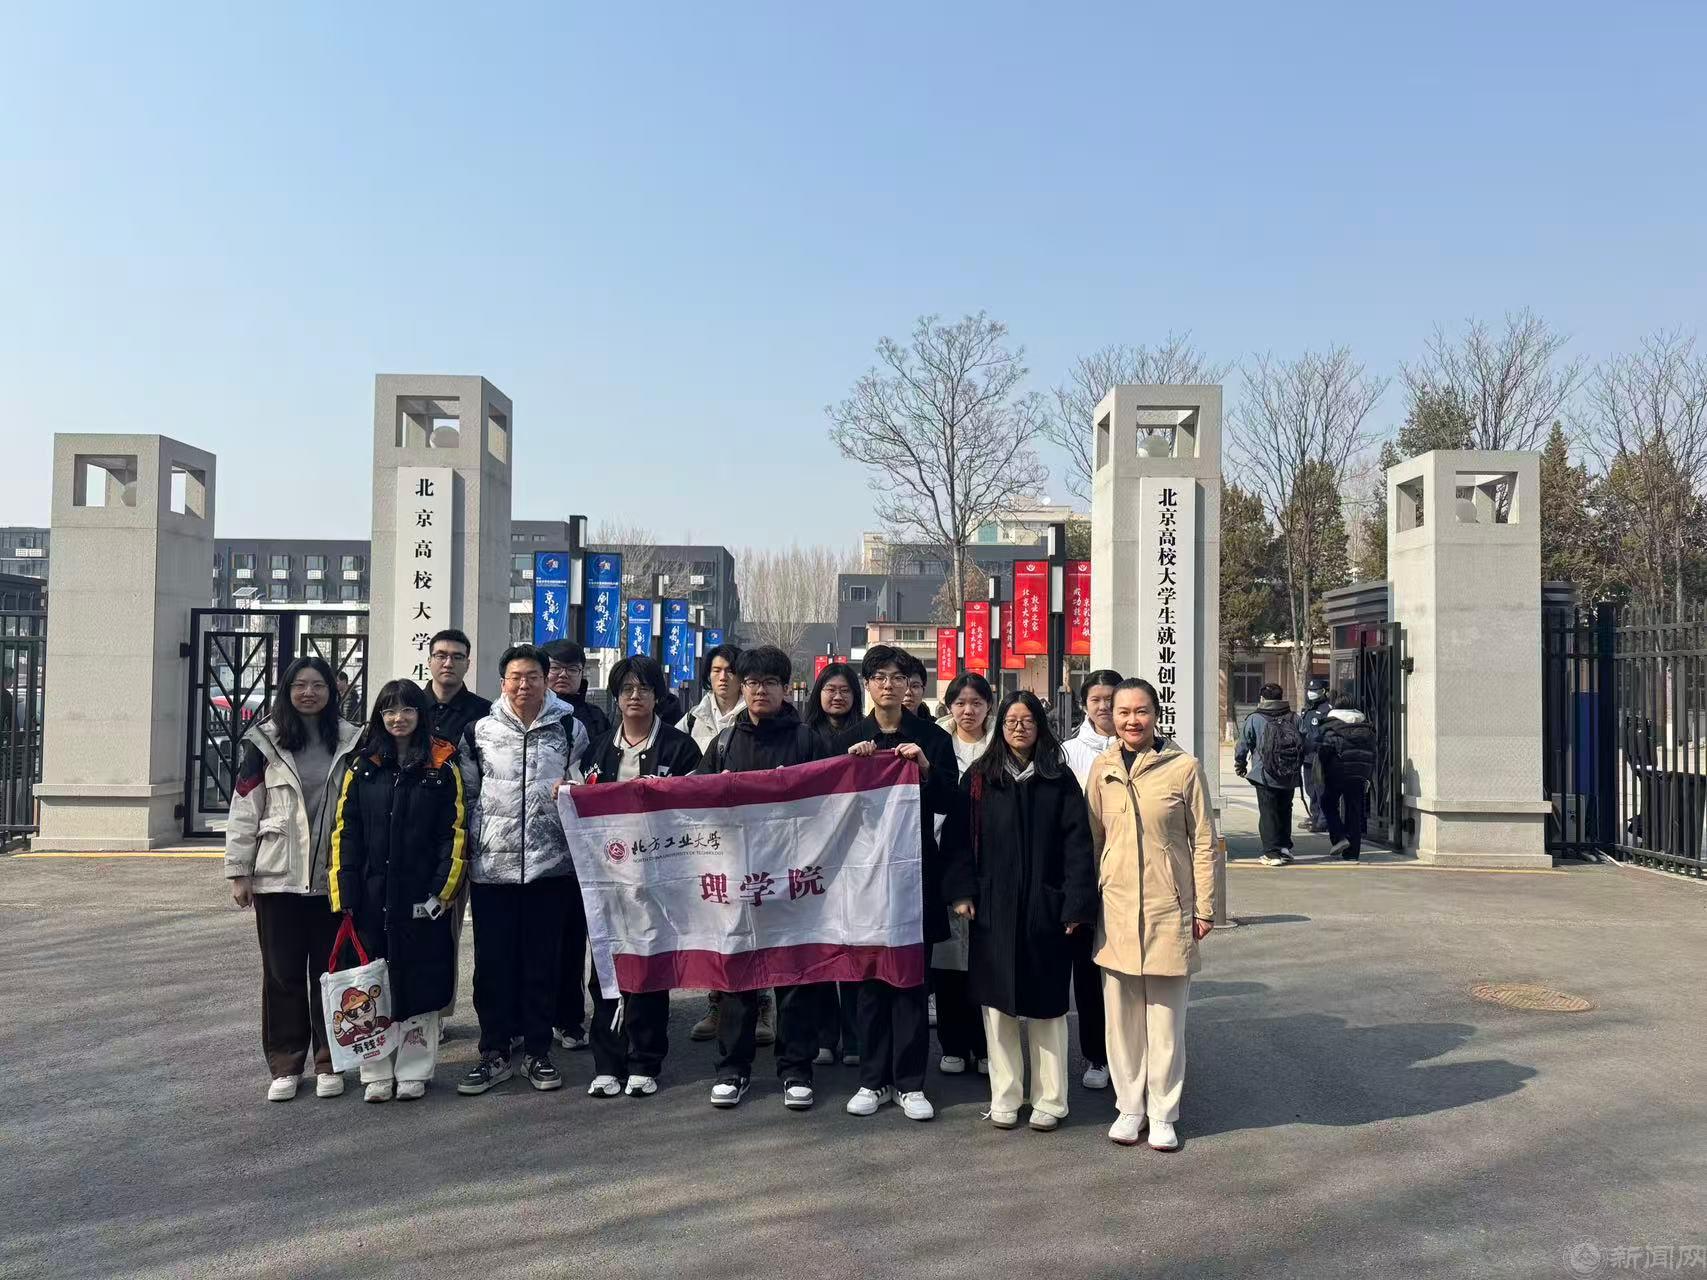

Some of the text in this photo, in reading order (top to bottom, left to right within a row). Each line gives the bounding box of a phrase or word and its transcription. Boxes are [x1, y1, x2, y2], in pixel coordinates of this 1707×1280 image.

[411, 478, 435, 682] 北京高校大学生
[631, 830, 722, 855] 北方工业大学
[698, 865, 826, 907] 理学院
